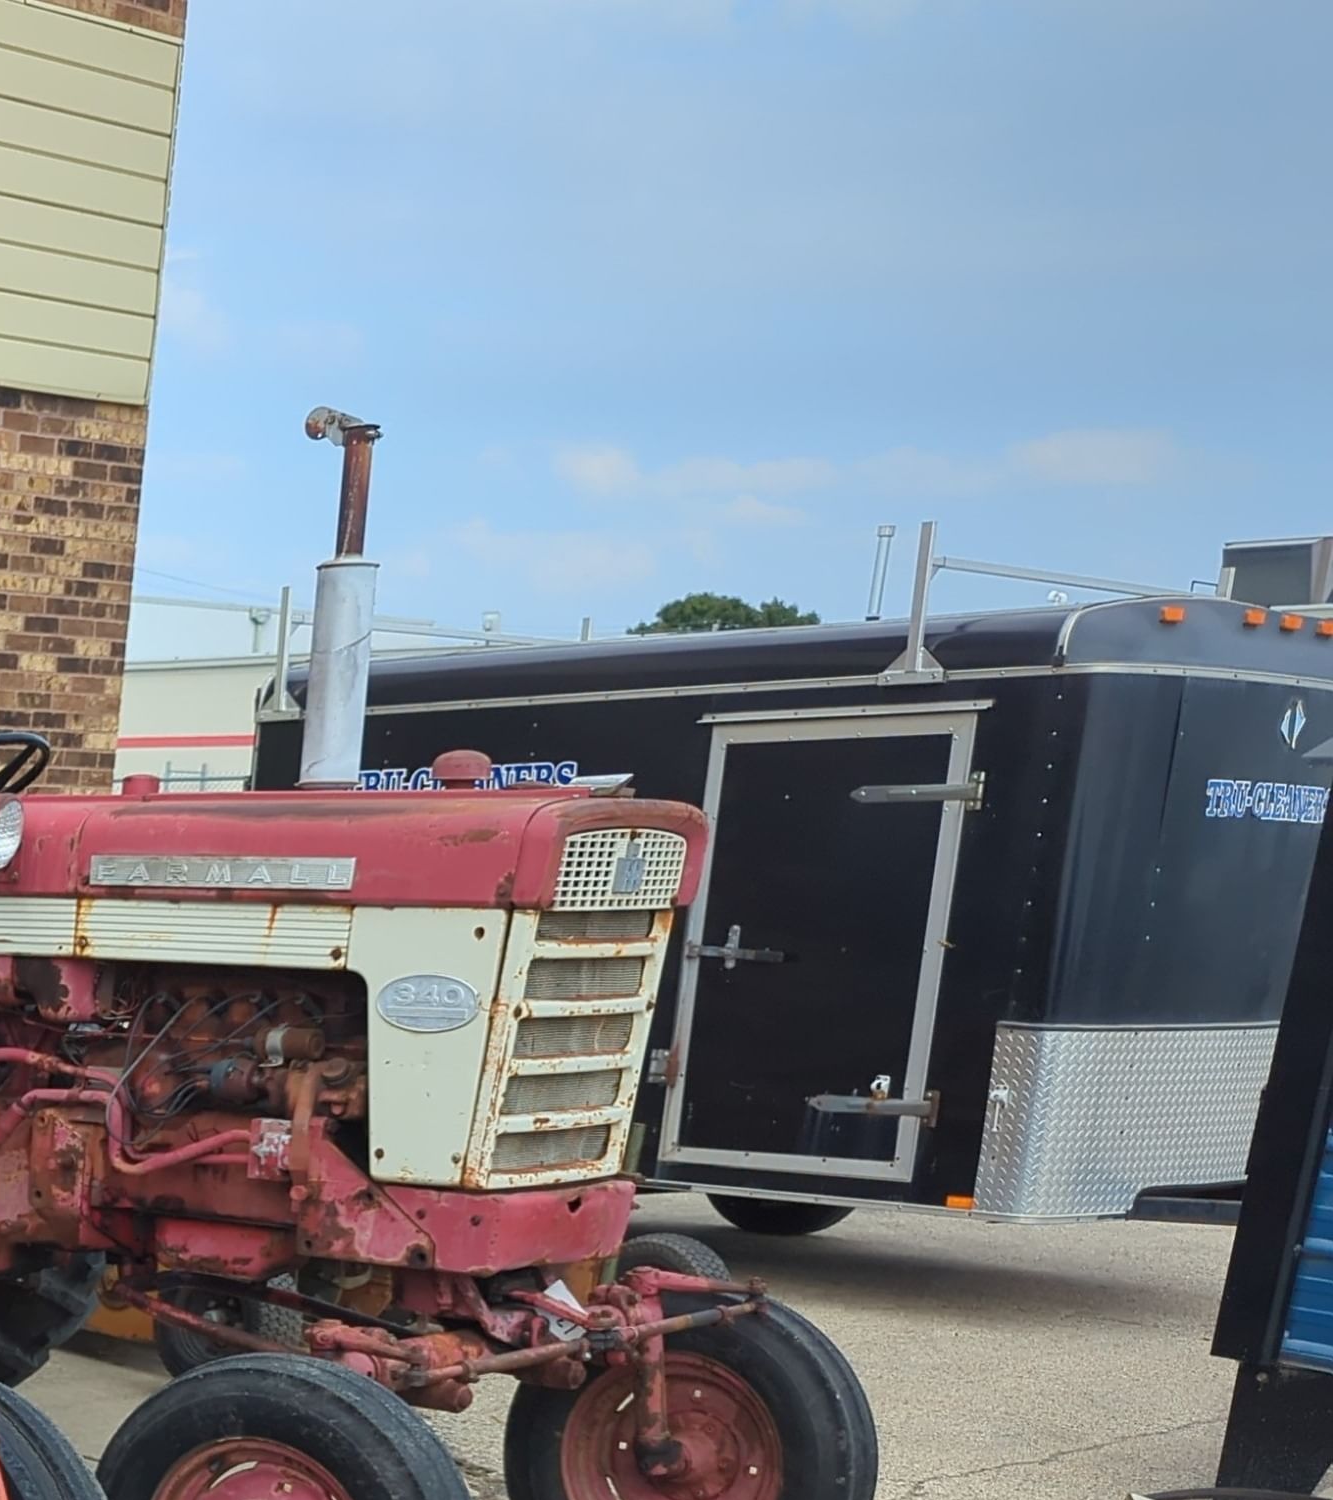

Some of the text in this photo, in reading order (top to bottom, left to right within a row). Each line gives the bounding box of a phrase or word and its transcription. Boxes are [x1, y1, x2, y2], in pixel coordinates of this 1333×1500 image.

[1206, 779, 1330, 824] TRU-CLEANER
[96, 862, 349, 886] FARMALL
[393, 983, 465, 1006] 340
